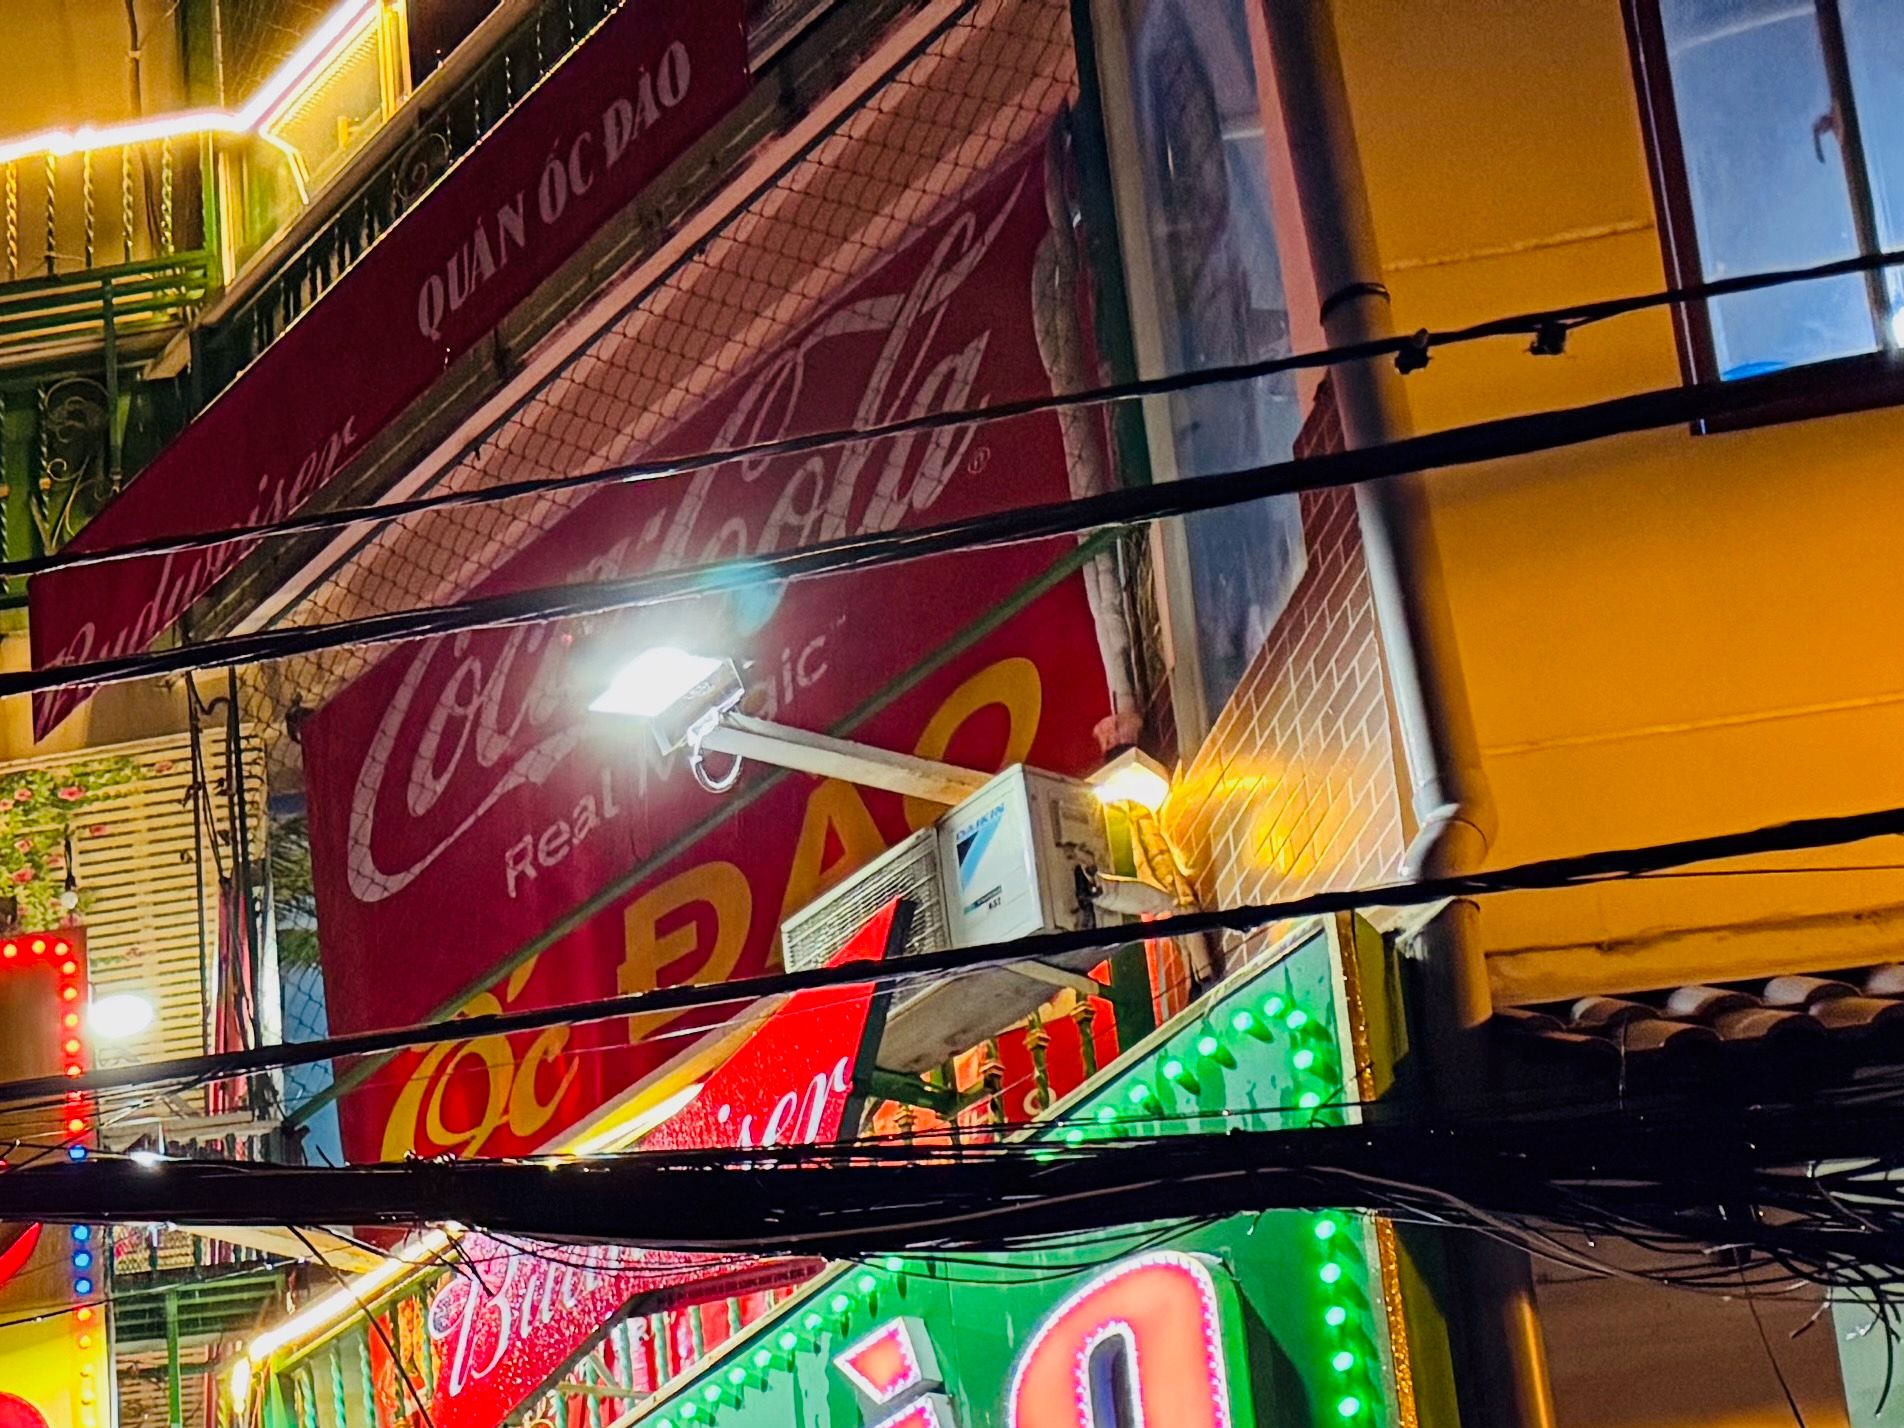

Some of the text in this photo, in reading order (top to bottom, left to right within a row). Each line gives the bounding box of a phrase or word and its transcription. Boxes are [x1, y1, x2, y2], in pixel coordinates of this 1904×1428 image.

[417, 40, 692, 342] QUÁN ỐC ĐÀO
